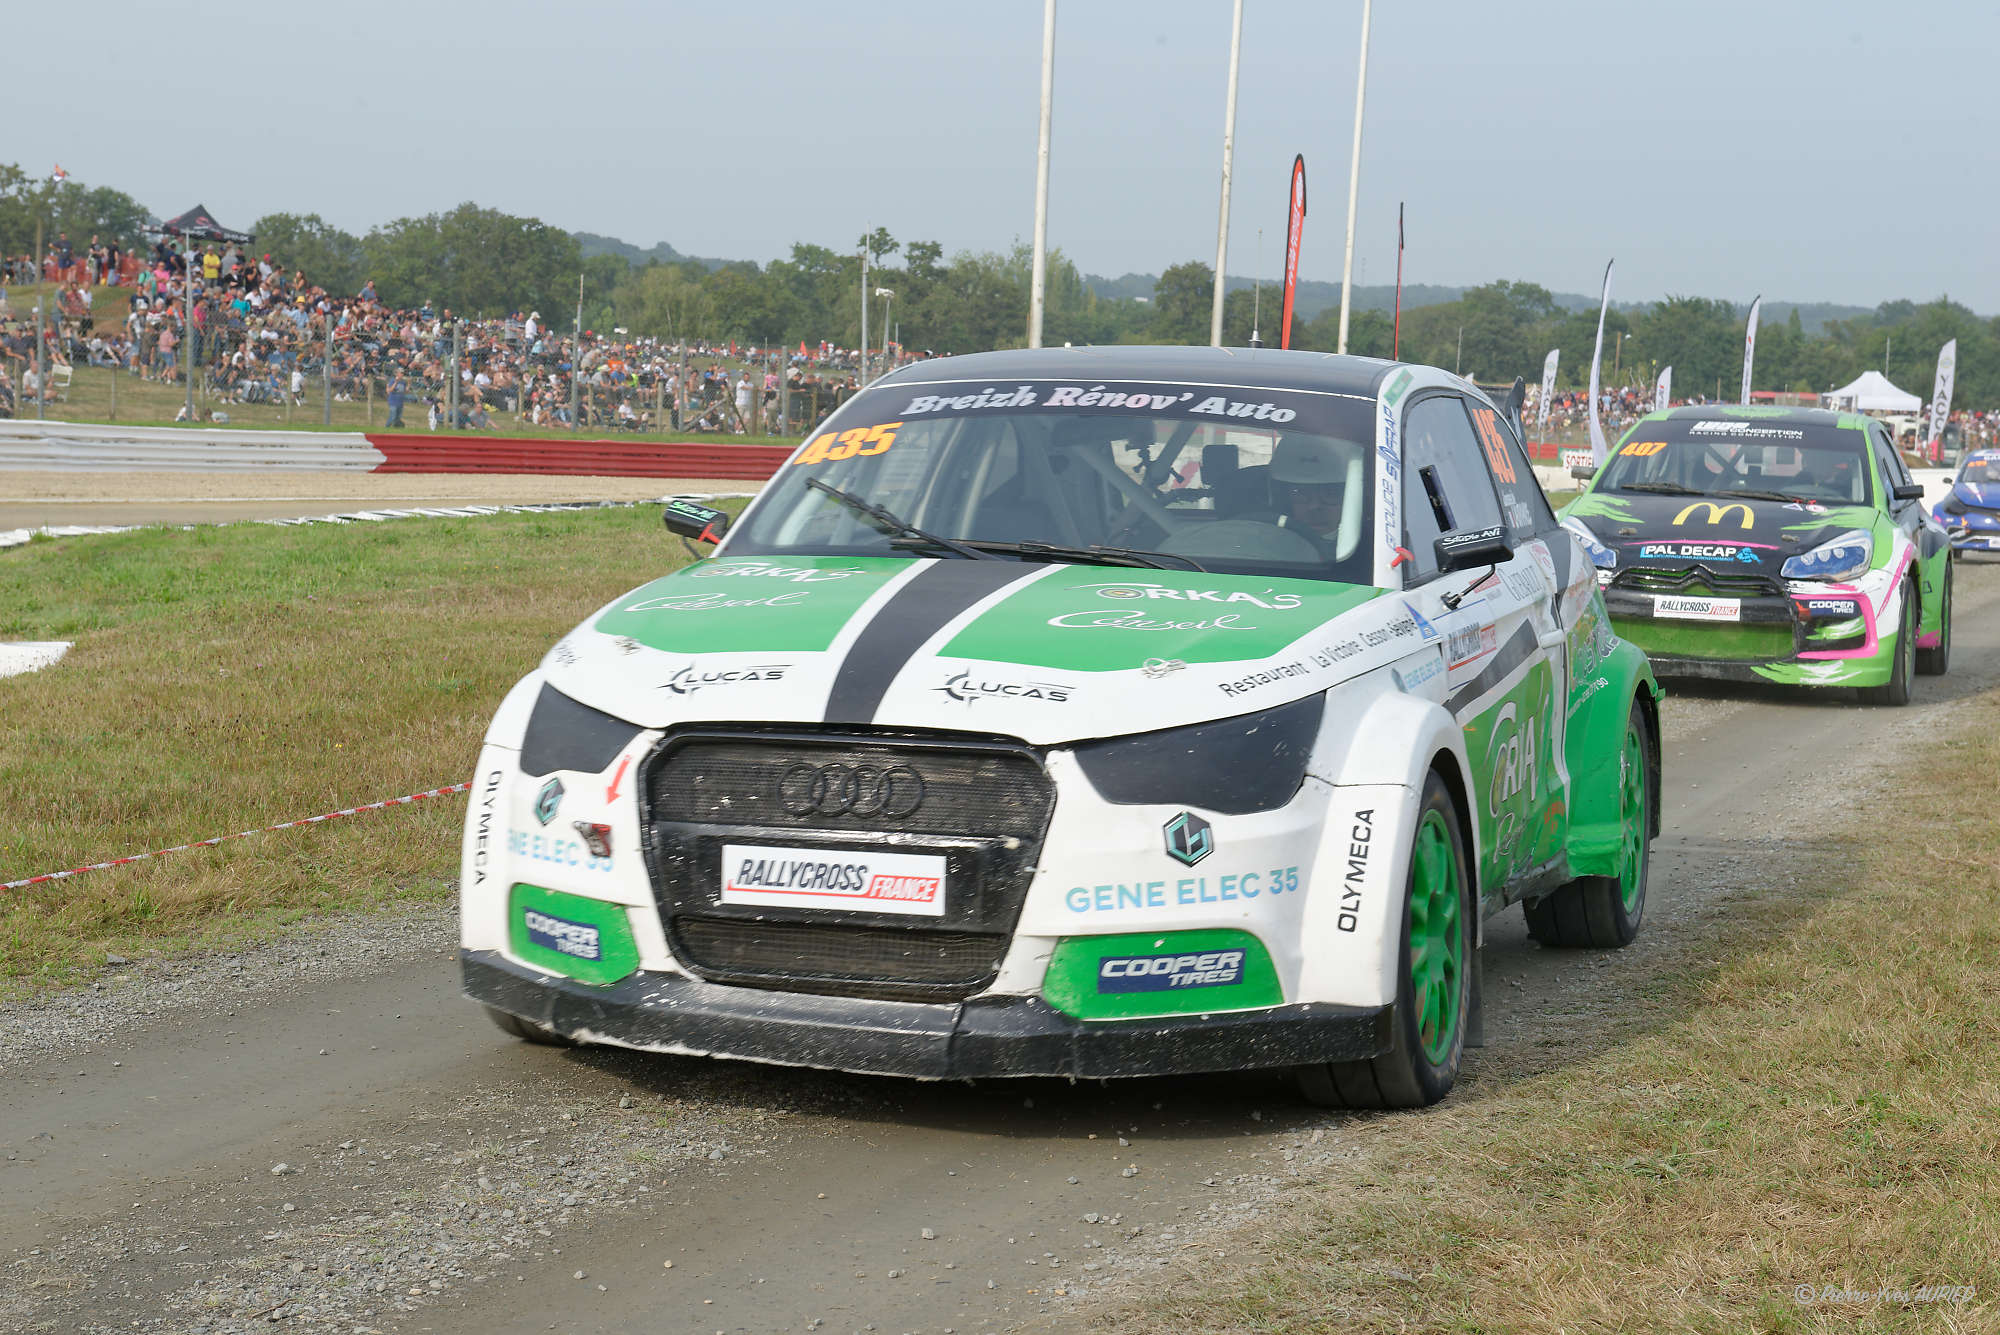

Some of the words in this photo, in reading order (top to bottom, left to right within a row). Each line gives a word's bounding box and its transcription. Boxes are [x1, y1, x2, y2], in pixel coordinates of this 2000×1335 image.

[901, 385, 1037, 416] Breizh
[1042, 384, 1195, 411] Rénov'
[1189, 396, 1297, 424] Auto
[793, 422, 904, 465] 435
[1728, 428, 1803, 436] CONCEPTION
[1619, 442, 1668, 457] 407
[1645, 545, 1676, 555] PAL
[1681, 546, 1737, 557] DECAP
[1088, 583, 1303, 610] ORKA'S
[1659, 600, 1712, 614] RALLYCROSS
[1711, 605, 1739, 617] FRANCE
[1809, 601, 1856, 609] COOPER
[1831, 607, 1855, 615] TIRES
[684, 671, 785, 684] LUCAS
[1218, 660, 1310, 698] Restaurant
[1310, 654, 1329, 669] La
[1324, 638, 1365, 664] Victoire
[960, 680, 1069, 702] LUCAS
[475, 770, 503, 886] OLYMECA
[532, 834, 579, 866] ELEC
[736, 858, 868, 891] RALLYCROSS
[869, 876, 940, 901] FRANCE
[1337, 809, 1375, 933] OLYMECA
[1065, 880, 1166, 913] GENE
[1177, 872, 1261, 905] ELEC
[1268, 866, 1299, 895] 35
[525, 911, 599, 943] COOPER
[1100, 951, 1244, 978] COOPER
[1167, 968, 1238, 988] TIRES
